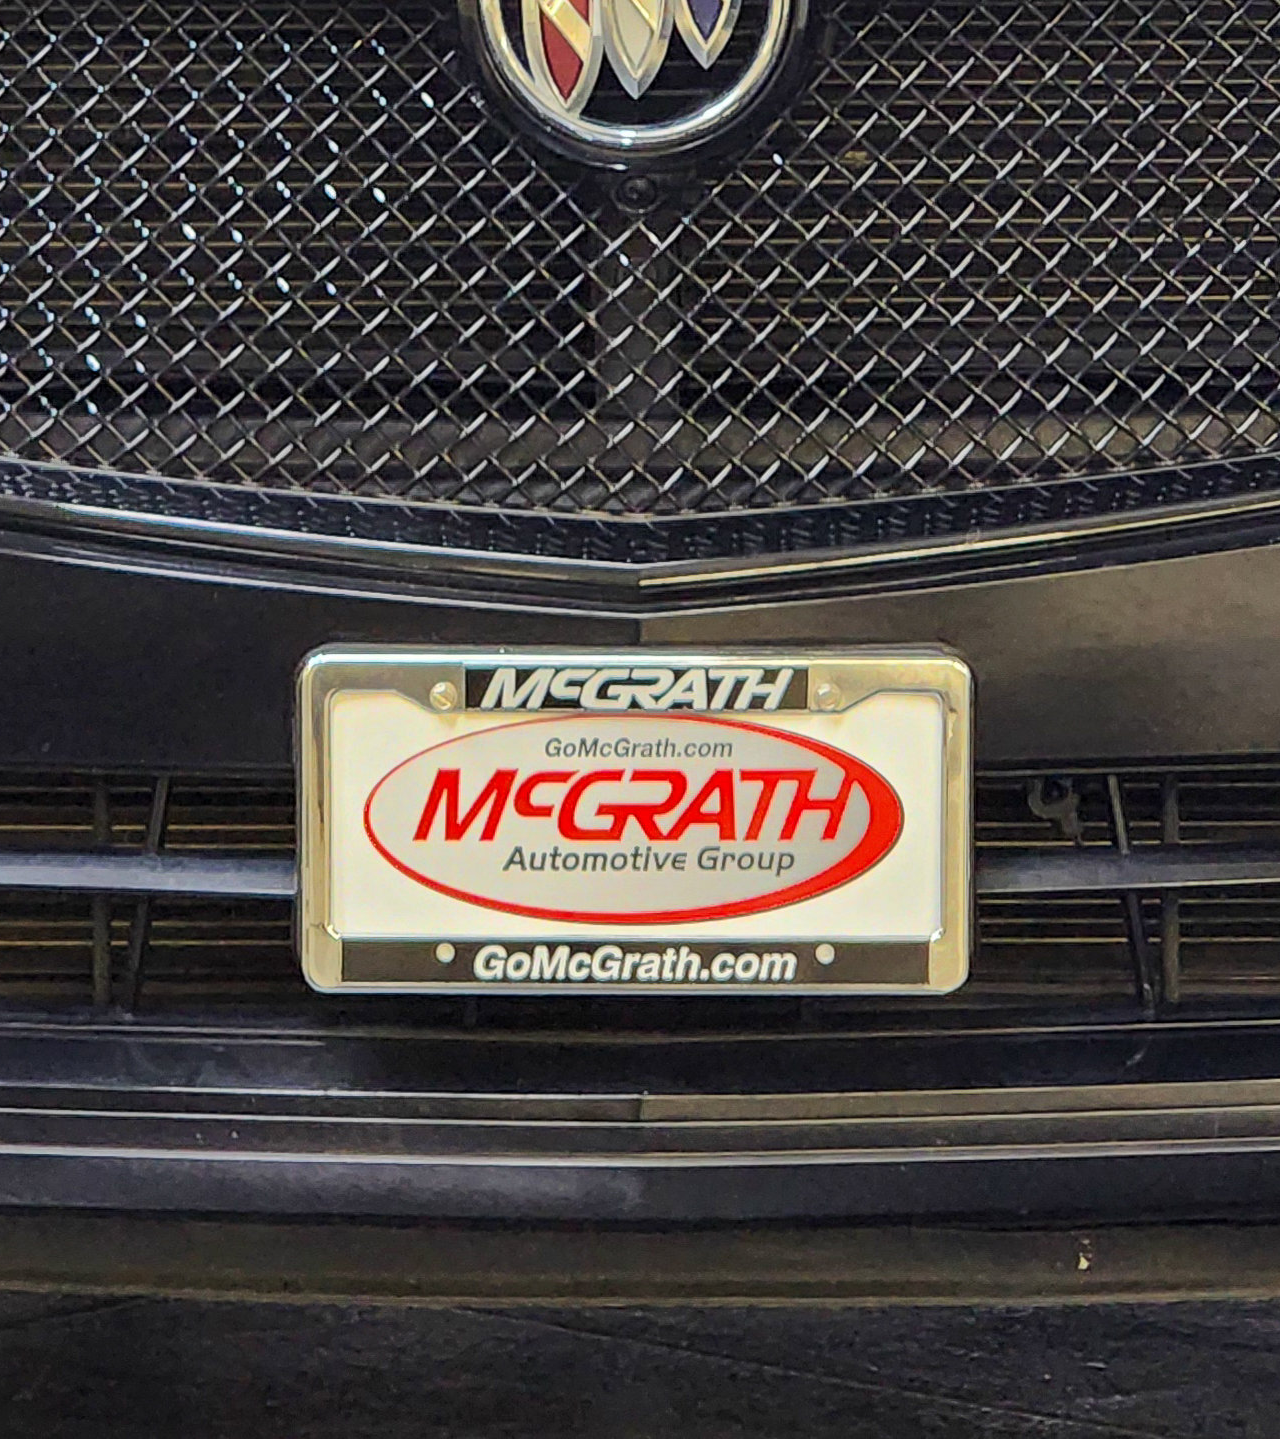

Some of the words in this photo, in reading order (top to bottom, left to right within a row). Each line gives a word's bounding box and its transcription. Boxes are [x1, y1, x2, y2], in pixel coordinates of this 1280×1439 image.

[545, 737, 733, 760] GoMcGrath.com
[502, 845, 687, 872] Automotive
[698, 845, 795, 875] Group
[475, 944, 798, 982] GoMcGrath.com
